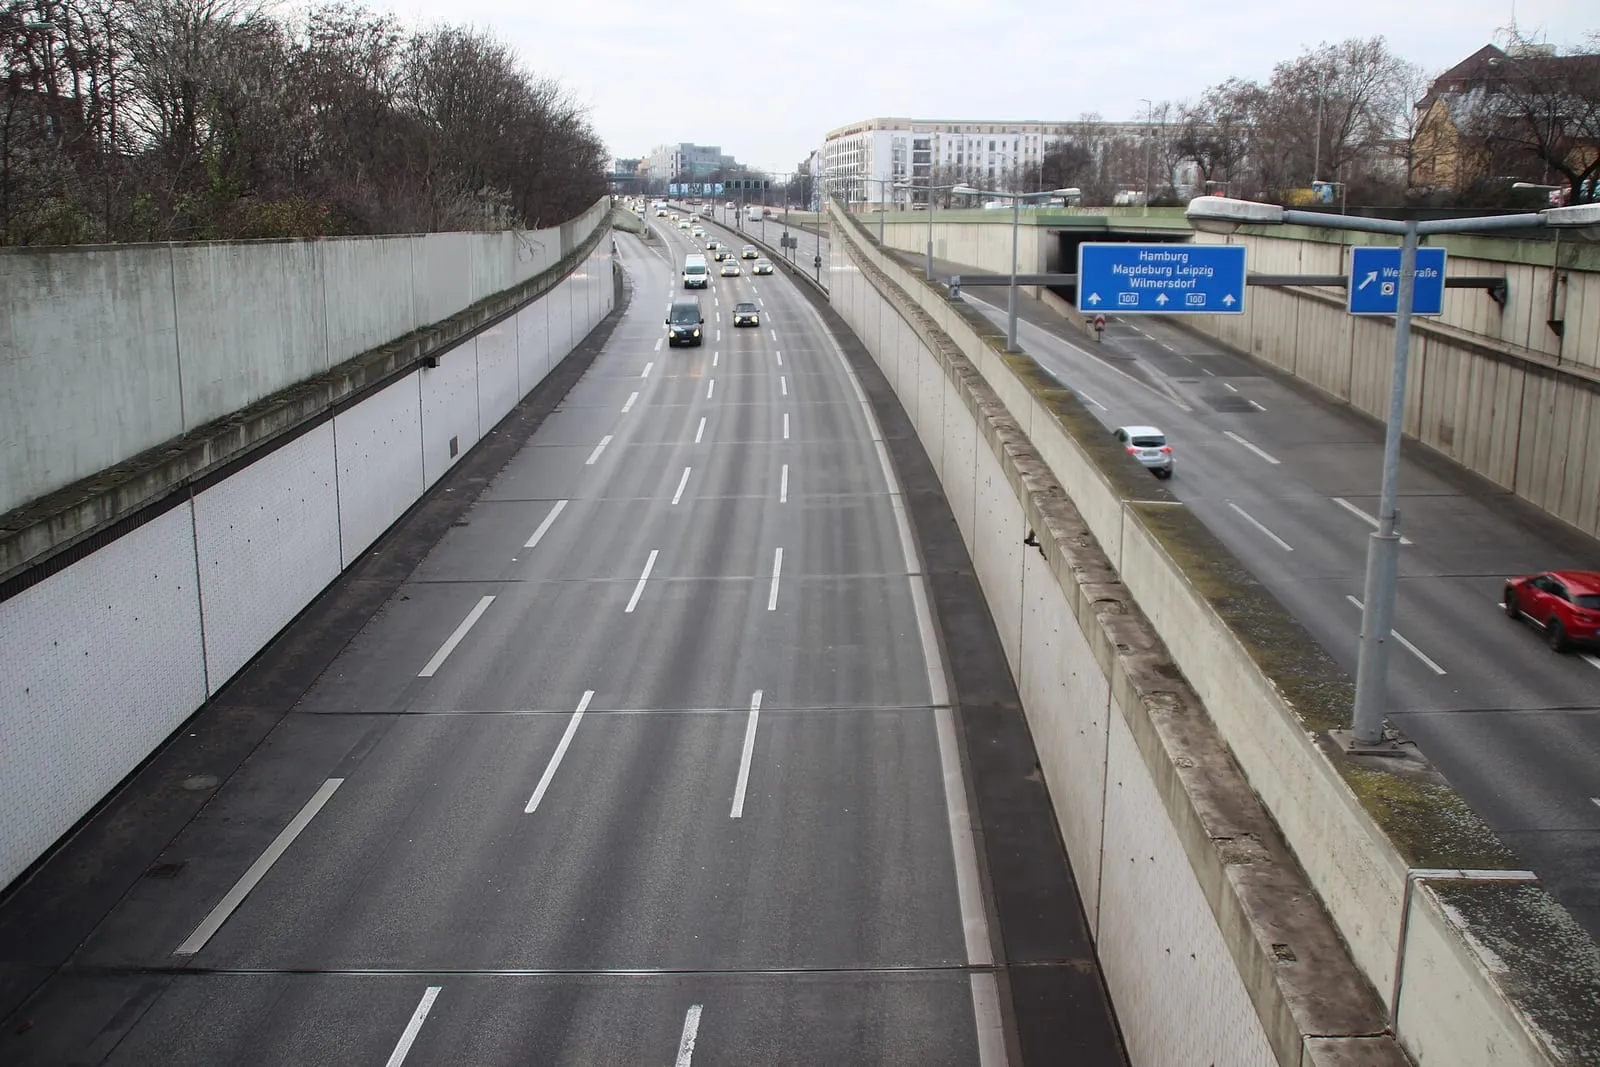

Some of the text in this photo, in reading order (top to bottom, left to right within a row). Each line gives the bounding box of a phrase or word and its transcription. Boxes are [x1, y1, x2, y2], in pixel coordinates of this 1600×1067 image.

[1139, 251, 1189, 263] Hamburg
[1113, 264, 1214, 277] Magdeburg Leipzig
[1383, 267, 1438, 277] Weraße
[1130, 278, 1197, 288] Wilmersdorf
[1122, 295, 1136, 303] 100
[1189, 295, 1203, 303] 100
